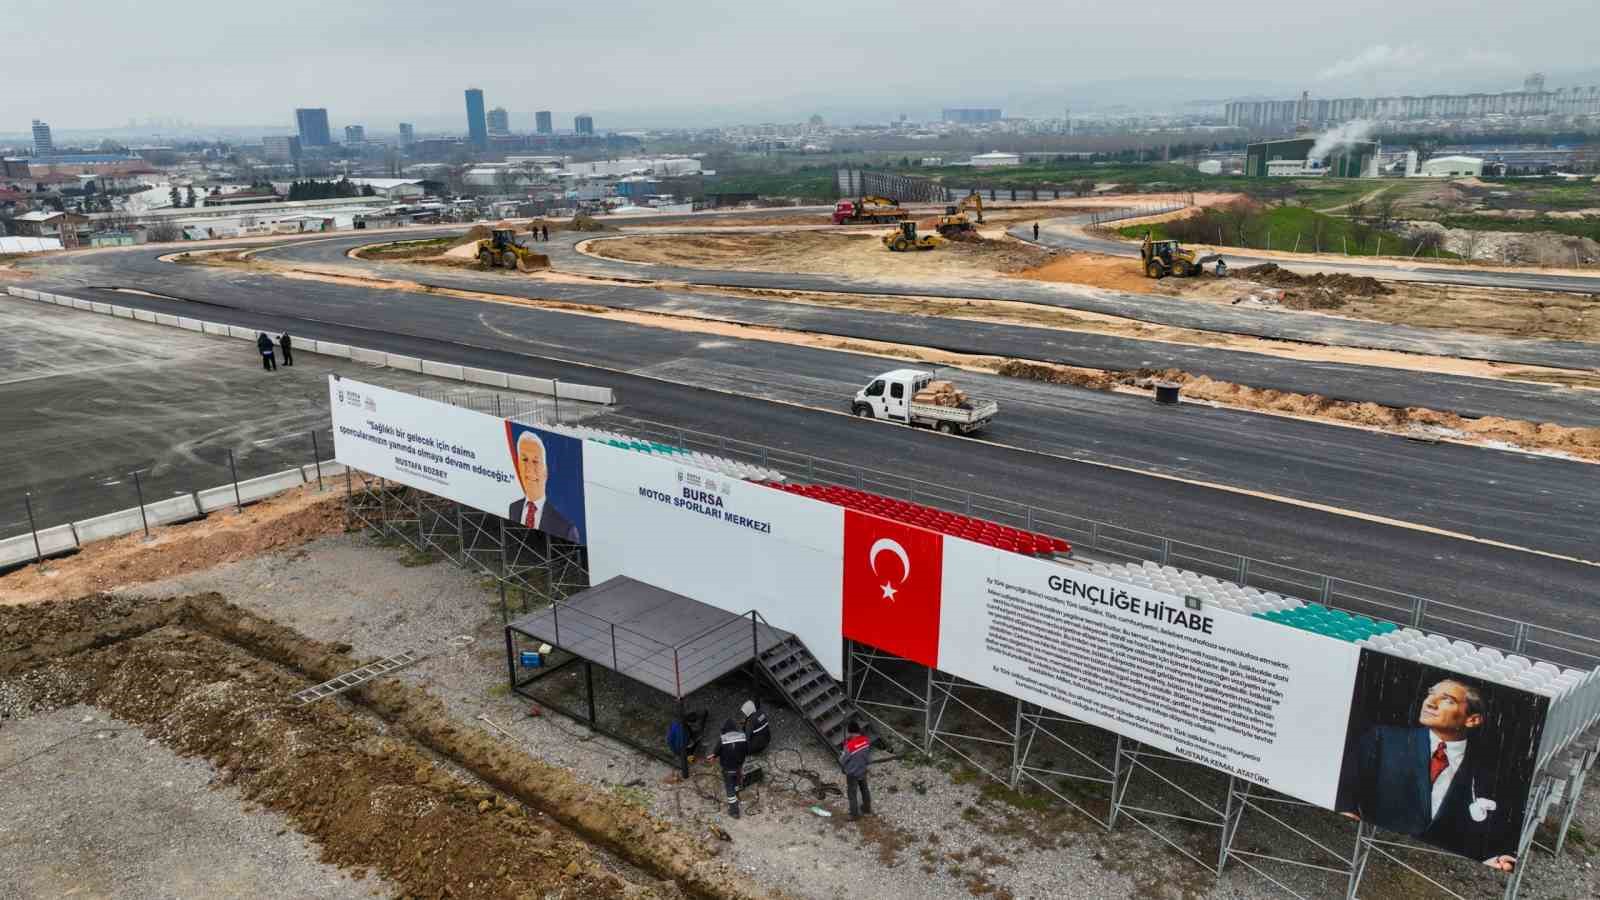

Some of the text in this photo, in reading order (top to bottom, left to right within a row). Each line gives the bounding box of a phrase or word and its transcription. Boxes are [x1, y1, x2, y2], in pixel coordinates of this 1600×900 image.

[395, 427, 405, 439] bir
[406, 431, 434, 447] gelecek
[436, 439, 450, 453] için
[451, 444, 476, 459] daima
[395, 456, 422, 471] MUSTAFA
[417, 448, 443, 463] olmaya
[445, 456, 470, 471] devam
[639, 487, 771, 534] MOTOR SPORLARI MERKEZİ
[683, 487, 723, 508] BURSA
[1048, 575, 1141, 615] GENÇLİĞE
[1144, 601, 1213, 635] HİTABE
[1176, 746, 1270, 785] MUSTAFA KEMAL ATATÜRK
